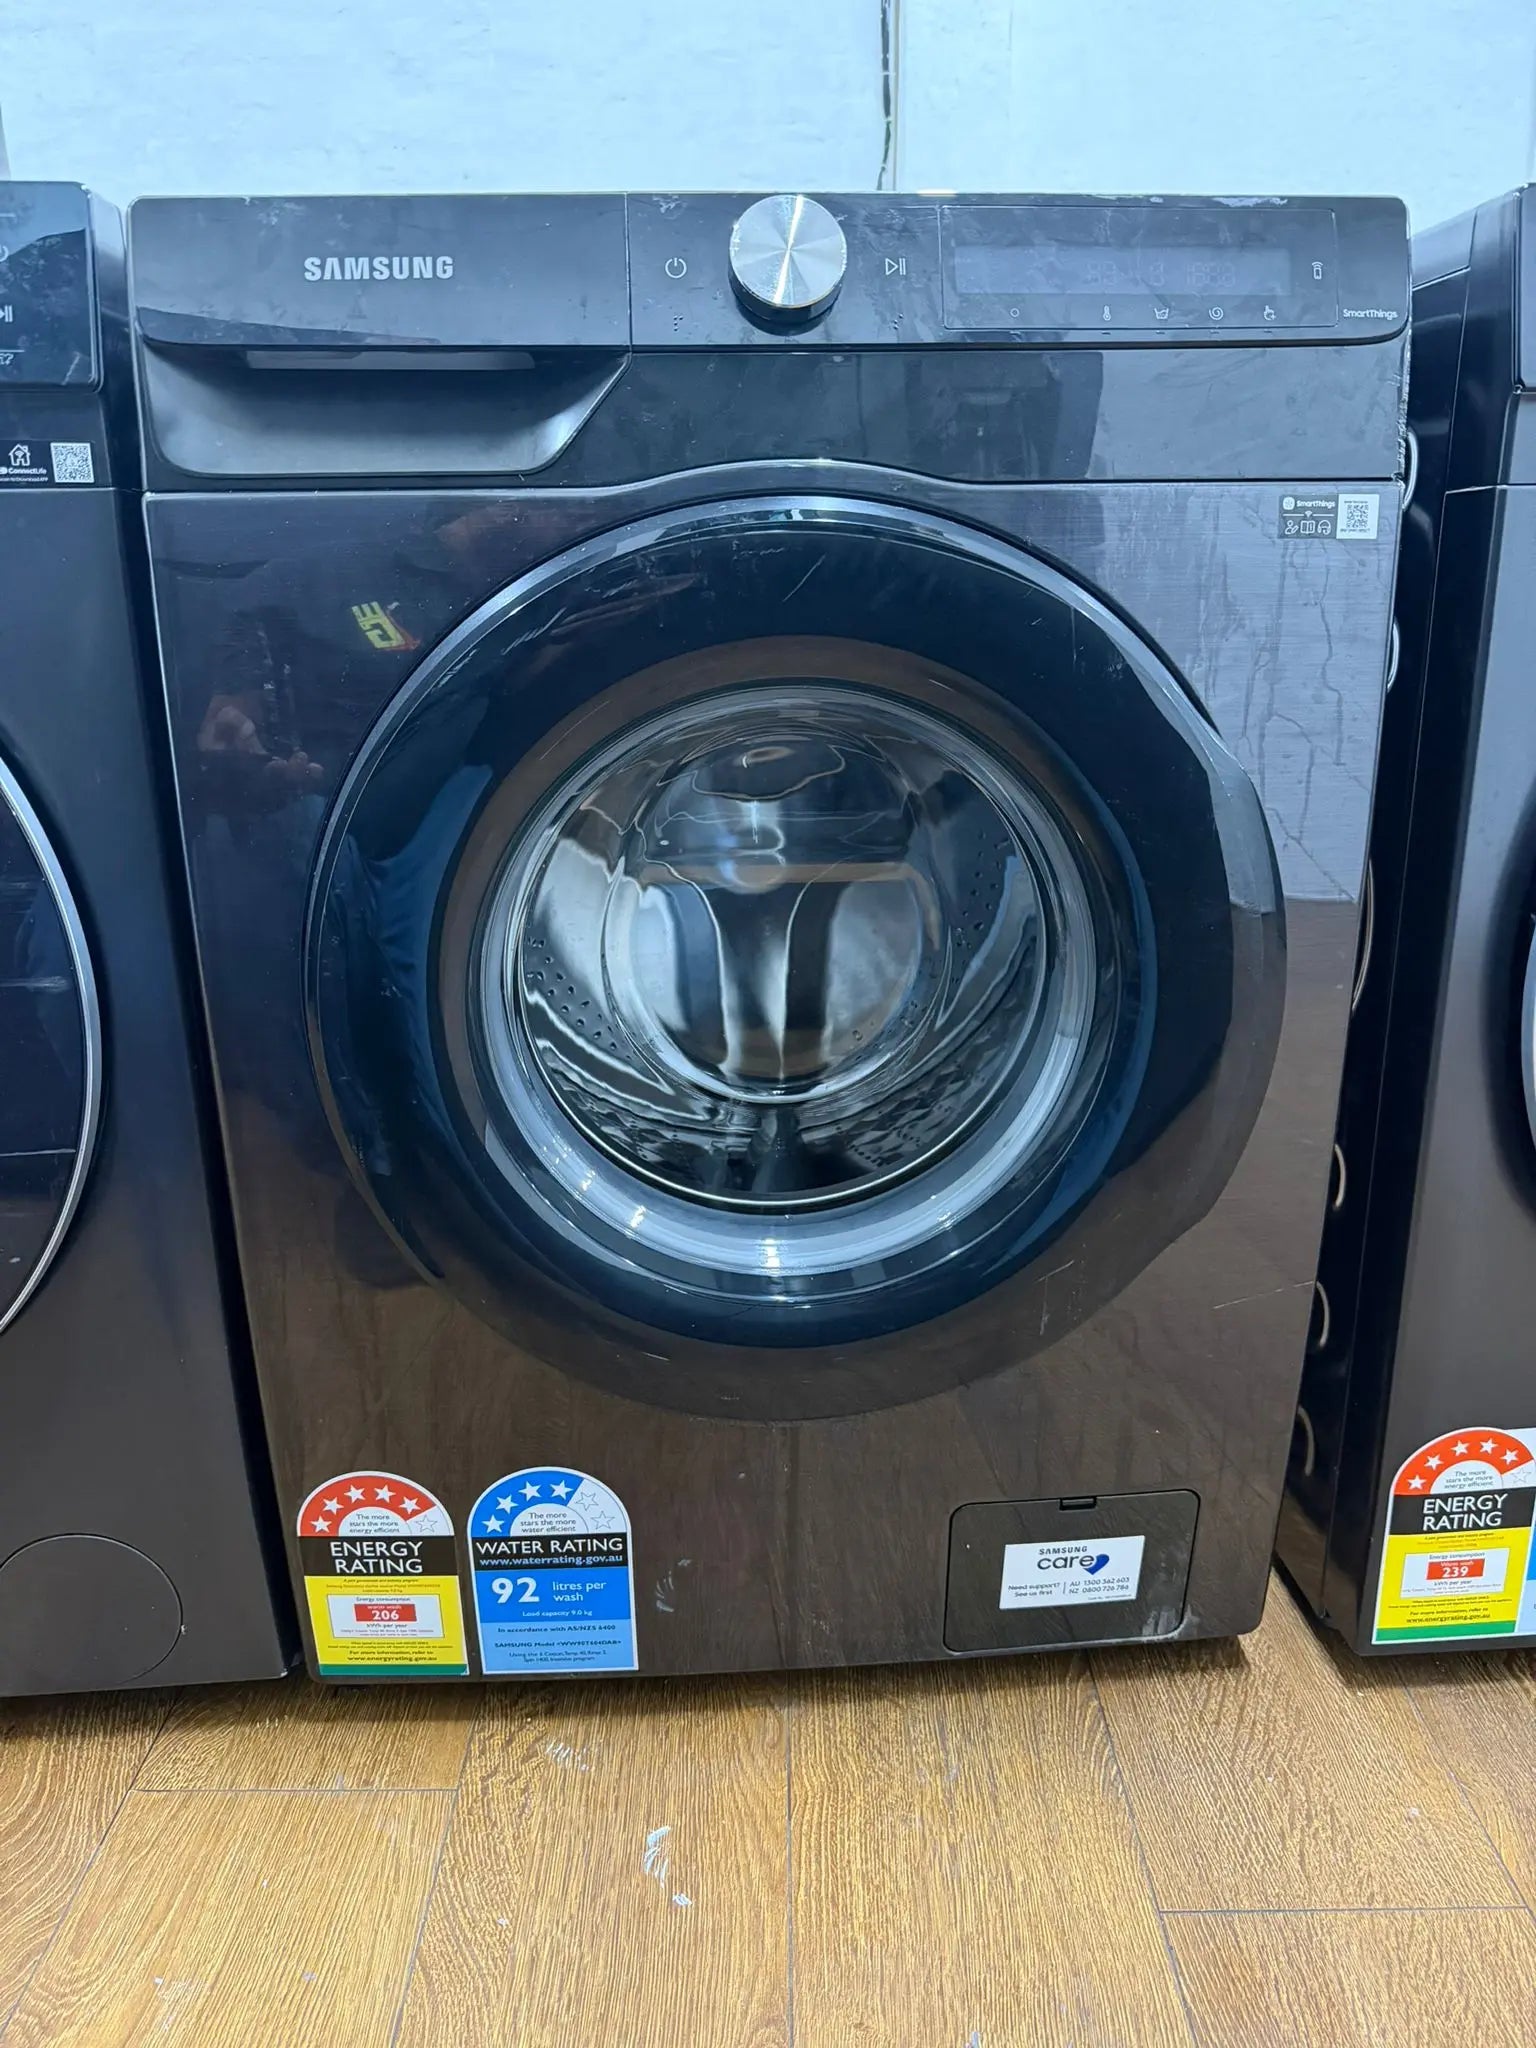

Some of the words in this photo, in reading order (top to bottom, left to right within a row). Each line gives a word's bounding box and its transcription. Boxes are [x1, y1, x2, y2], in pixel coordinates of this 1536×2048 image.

[304, 256, 454, 282] SAMSUNG
[1343, 308, 1398, 321] SmartThings
[9, 467, 47, 475] ConnectLife
[1296, 500, 1336, 509] SmartThings
[1423, 1493, 1508, 1514] ENERGY
[1423, 1511, 1502, 1531] RATING
[330, 1541, 423, 1557] ENERGY
[476, 1541, 545, 1555] WATER
[550, 1538, 623, 1553] RATING
[1039, 1546, 1088, 1555] SAMSUNG
[480, 1555, 623, 1566] www.waterrating.gov.au
[1037, 1555, 1095, 1570] care
[335, 1559, 423, 1574] RATING
[1442, 1567, 1469, 1578] 239
[491, 1577, 540, 1604] 92
[552, 1581, 582, 1591] litres
[586, 1582, 607, 1592] per
[1029, 1582, 1060, 1590] support?
[553, 1592, 584, 1602] wash
[372, 1610, 400, 1620] 206
[541, 1610, 571, 1618] capacity
